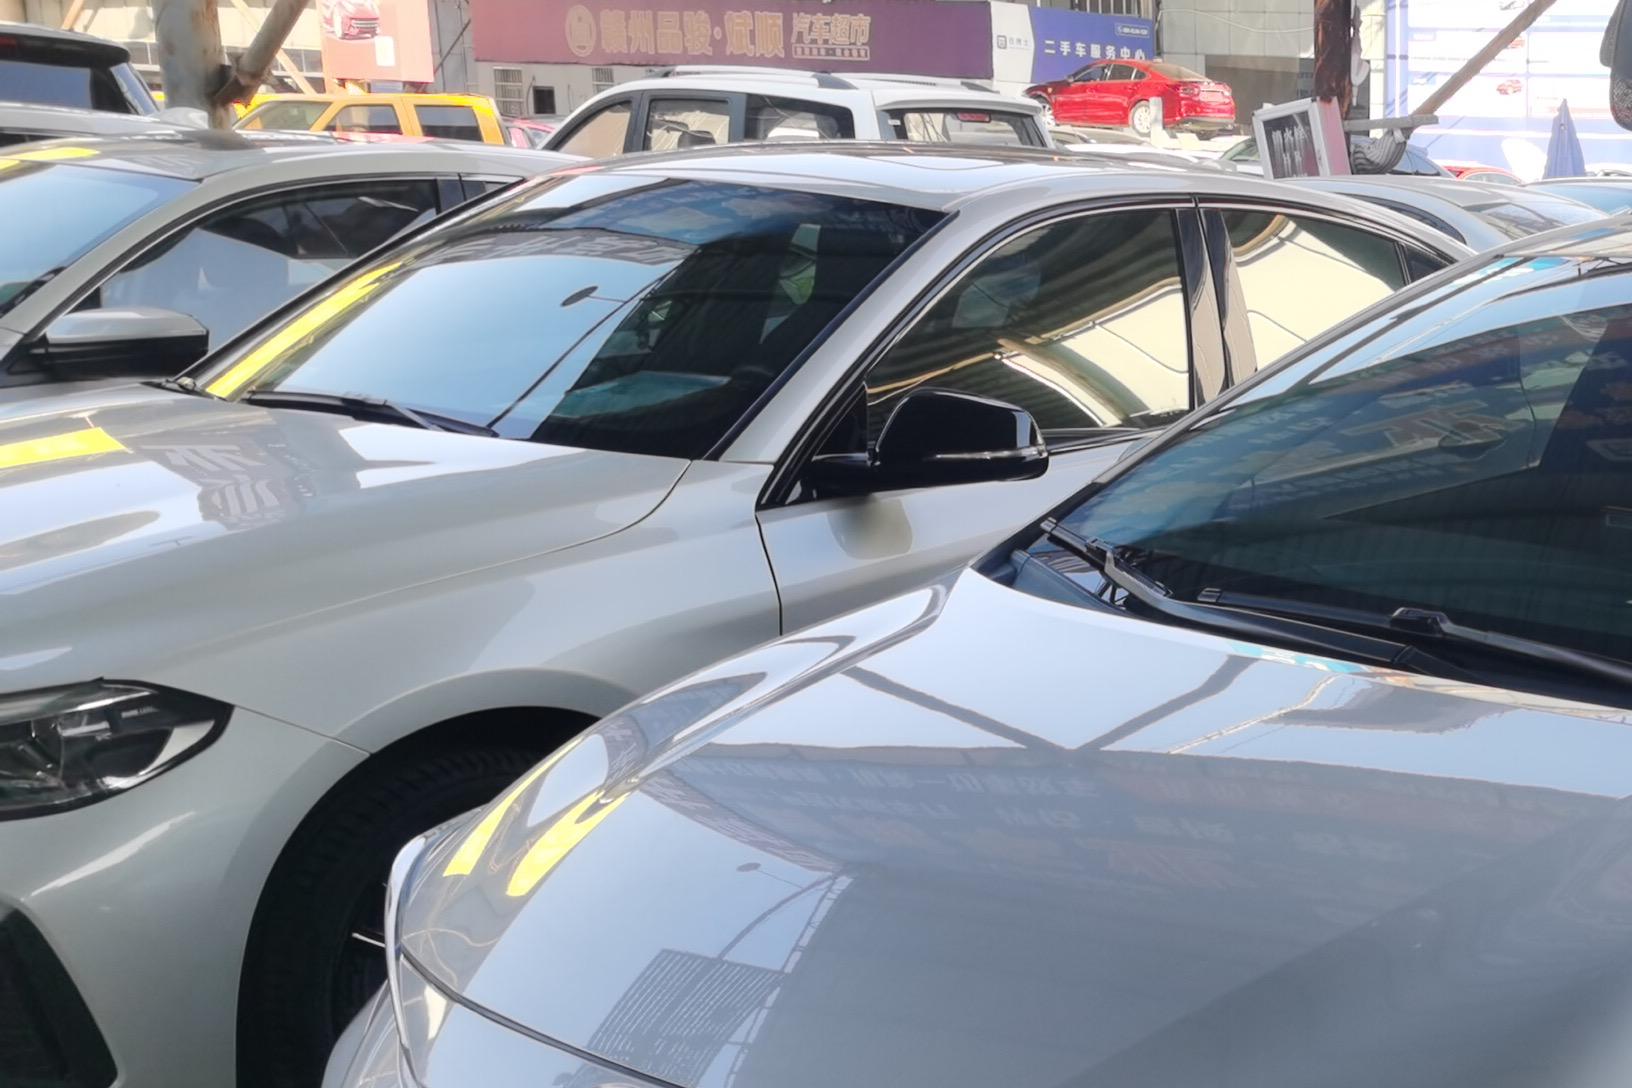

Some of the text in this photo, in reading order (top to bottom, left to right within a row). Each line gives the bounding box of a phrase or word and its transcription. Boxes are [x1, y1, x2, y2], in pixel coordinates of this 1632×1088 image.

[790, 12, 871, 46] 汽车超市
[1044, 40, 1146, 61] 二手车服务中心
